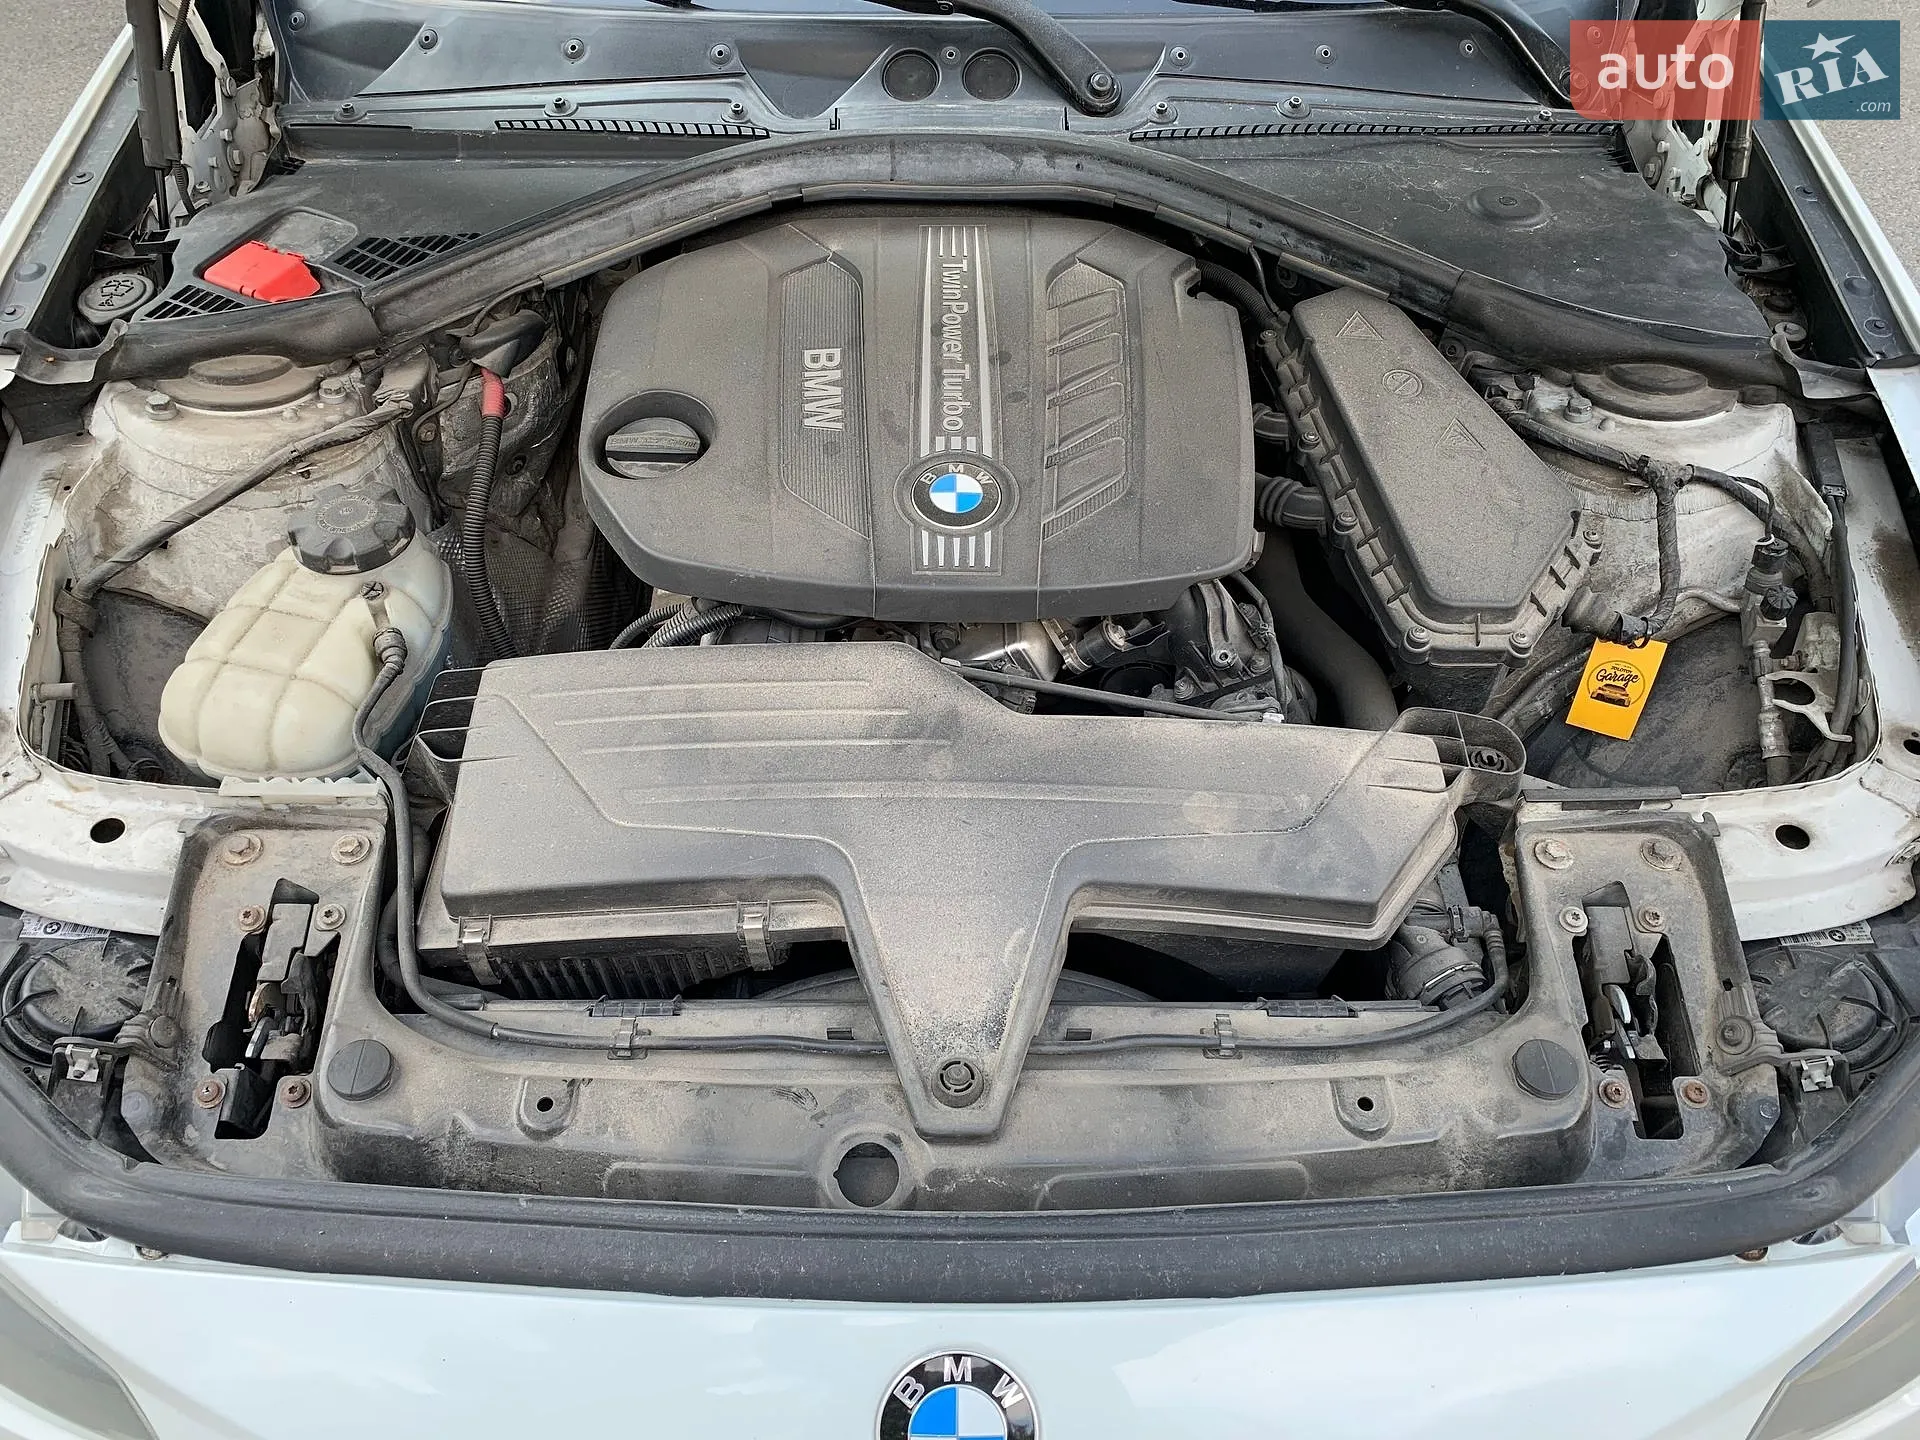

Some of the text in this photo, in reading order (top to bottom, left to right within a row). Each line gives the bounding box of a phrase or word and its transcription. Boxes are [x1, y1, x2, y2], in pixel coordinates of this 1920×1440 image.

[941, 259, 971, 432] TwinPower Turbo
[802, 348, 845, 431] BMW
[919, 463, 995, 485] BMW
[1596, 669, 1640, 688] Garage
[893, 1355, 1026, 1410] BMW
